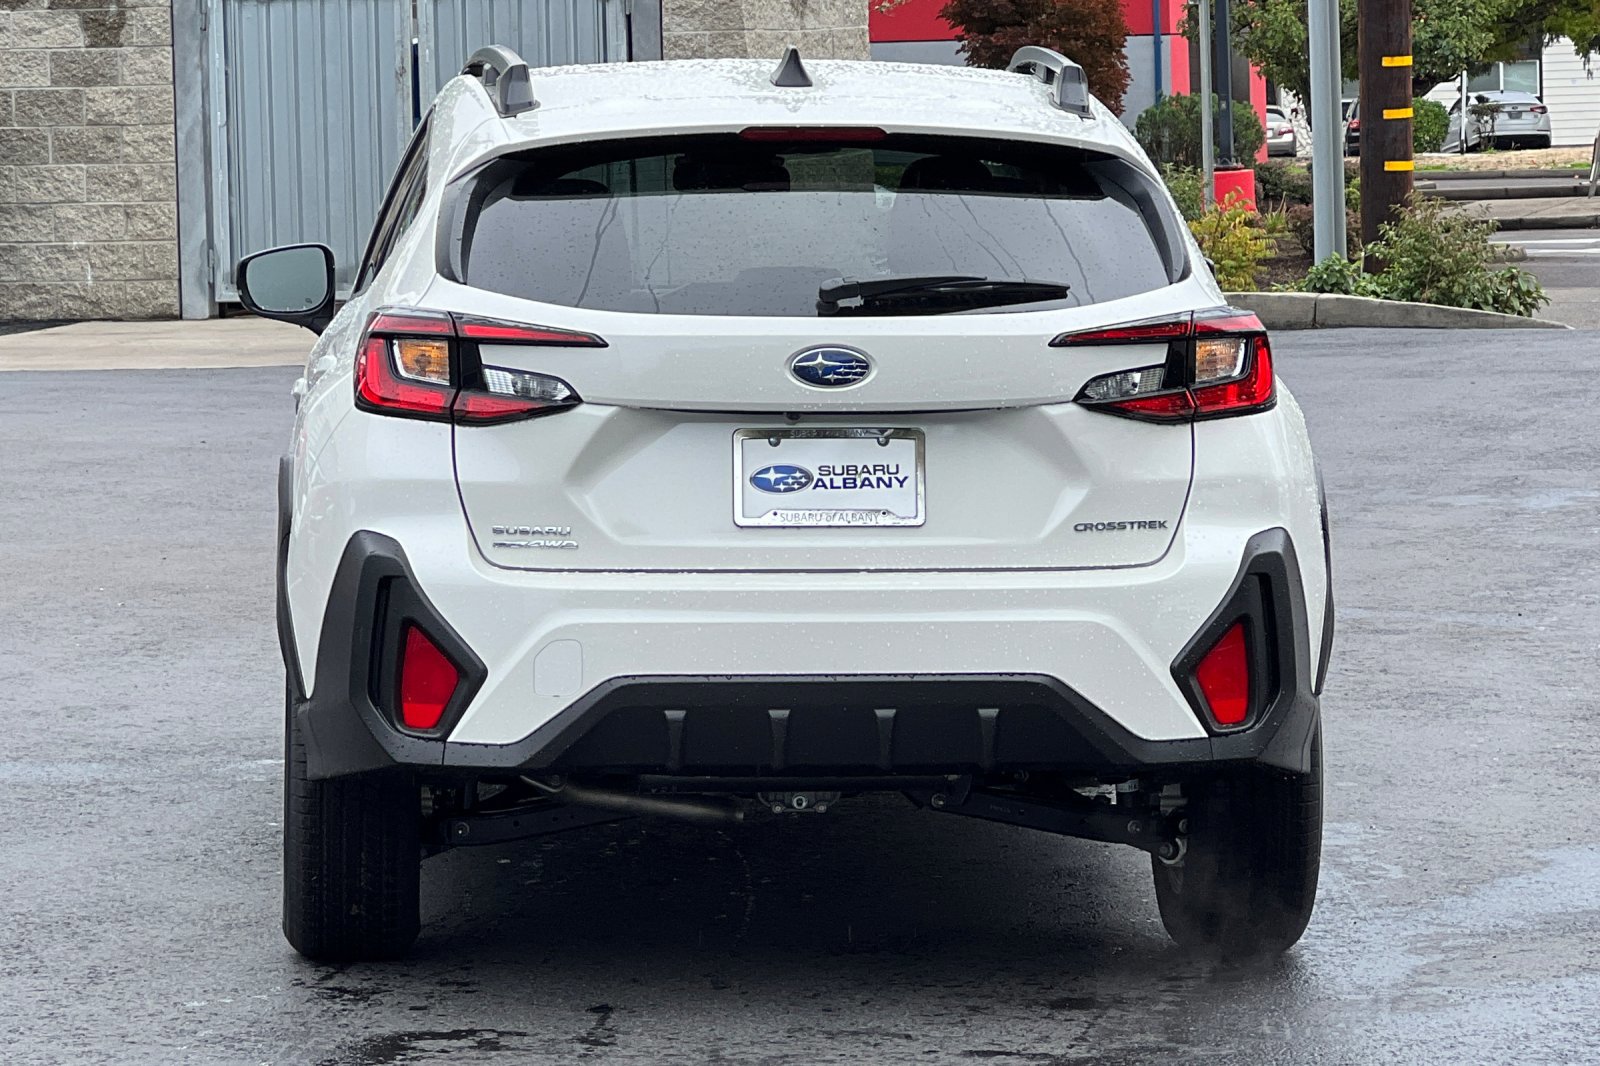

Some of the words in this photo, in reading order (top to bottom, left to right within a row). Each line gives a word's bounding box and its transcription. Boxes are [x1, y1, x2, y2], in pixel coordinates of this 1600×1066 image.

[818, 464, 899, 476] SUBARU
[812, 476, 909, 489] ALBANY
[780, 512, 822, 522] SUBARU
[825, 511, 836, 522] of
[838, 512, 879, 522] ALBANY
[492, 525, 571, 536] SUBARU
[1073, 520, 1168, 532] CROSSTREK
